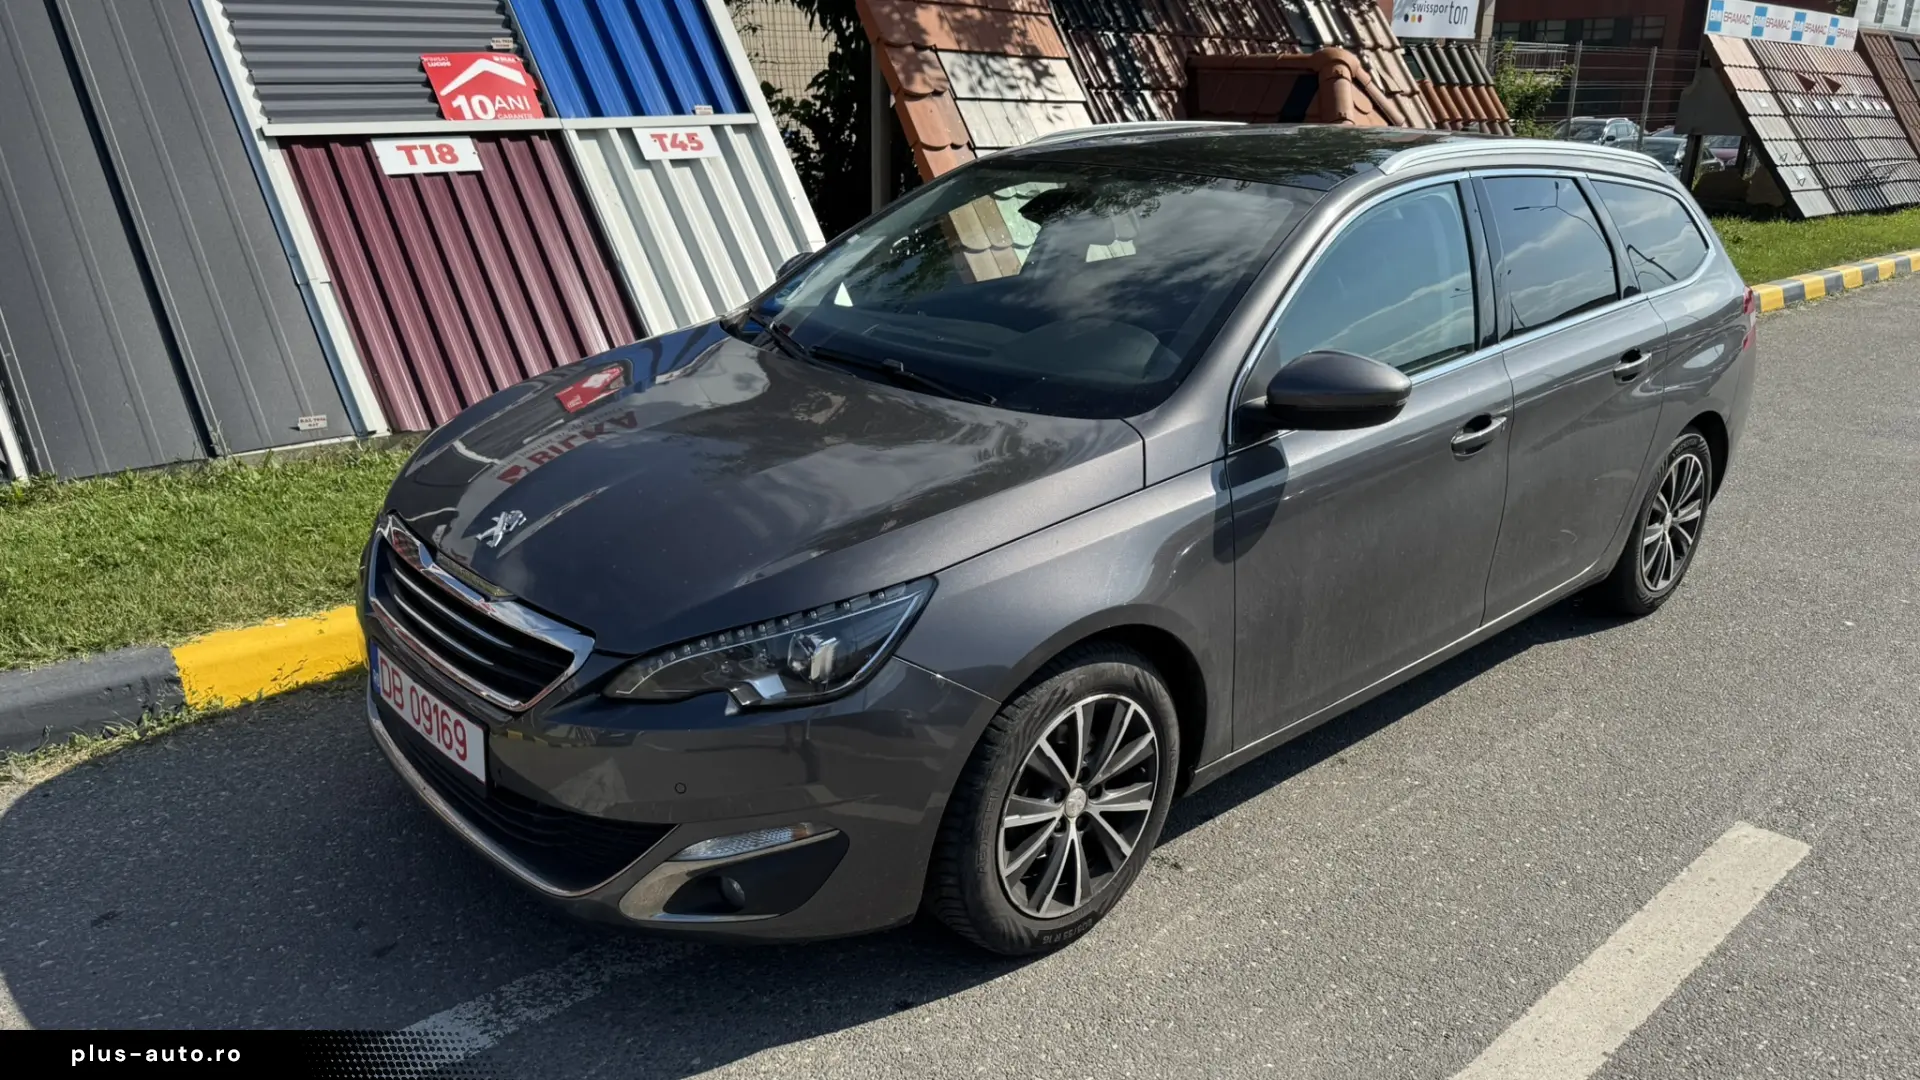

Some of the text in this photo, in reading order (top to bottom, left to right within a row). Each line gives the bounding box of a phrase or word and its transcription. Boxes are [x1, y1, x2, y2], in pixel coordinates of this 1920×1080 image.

[1724, 11, 1751, 26] BRAMAC
[1765, 17, 1791, 31] BRAMAC
[1804, 22, 1828, 35] BRAMAC
[451, 94, 531, 120] 10 ANI
[650, 132, 705, 153] T45
[395, 143, 460, 167] T18
[380, 656, 468, 761] DB 09169
